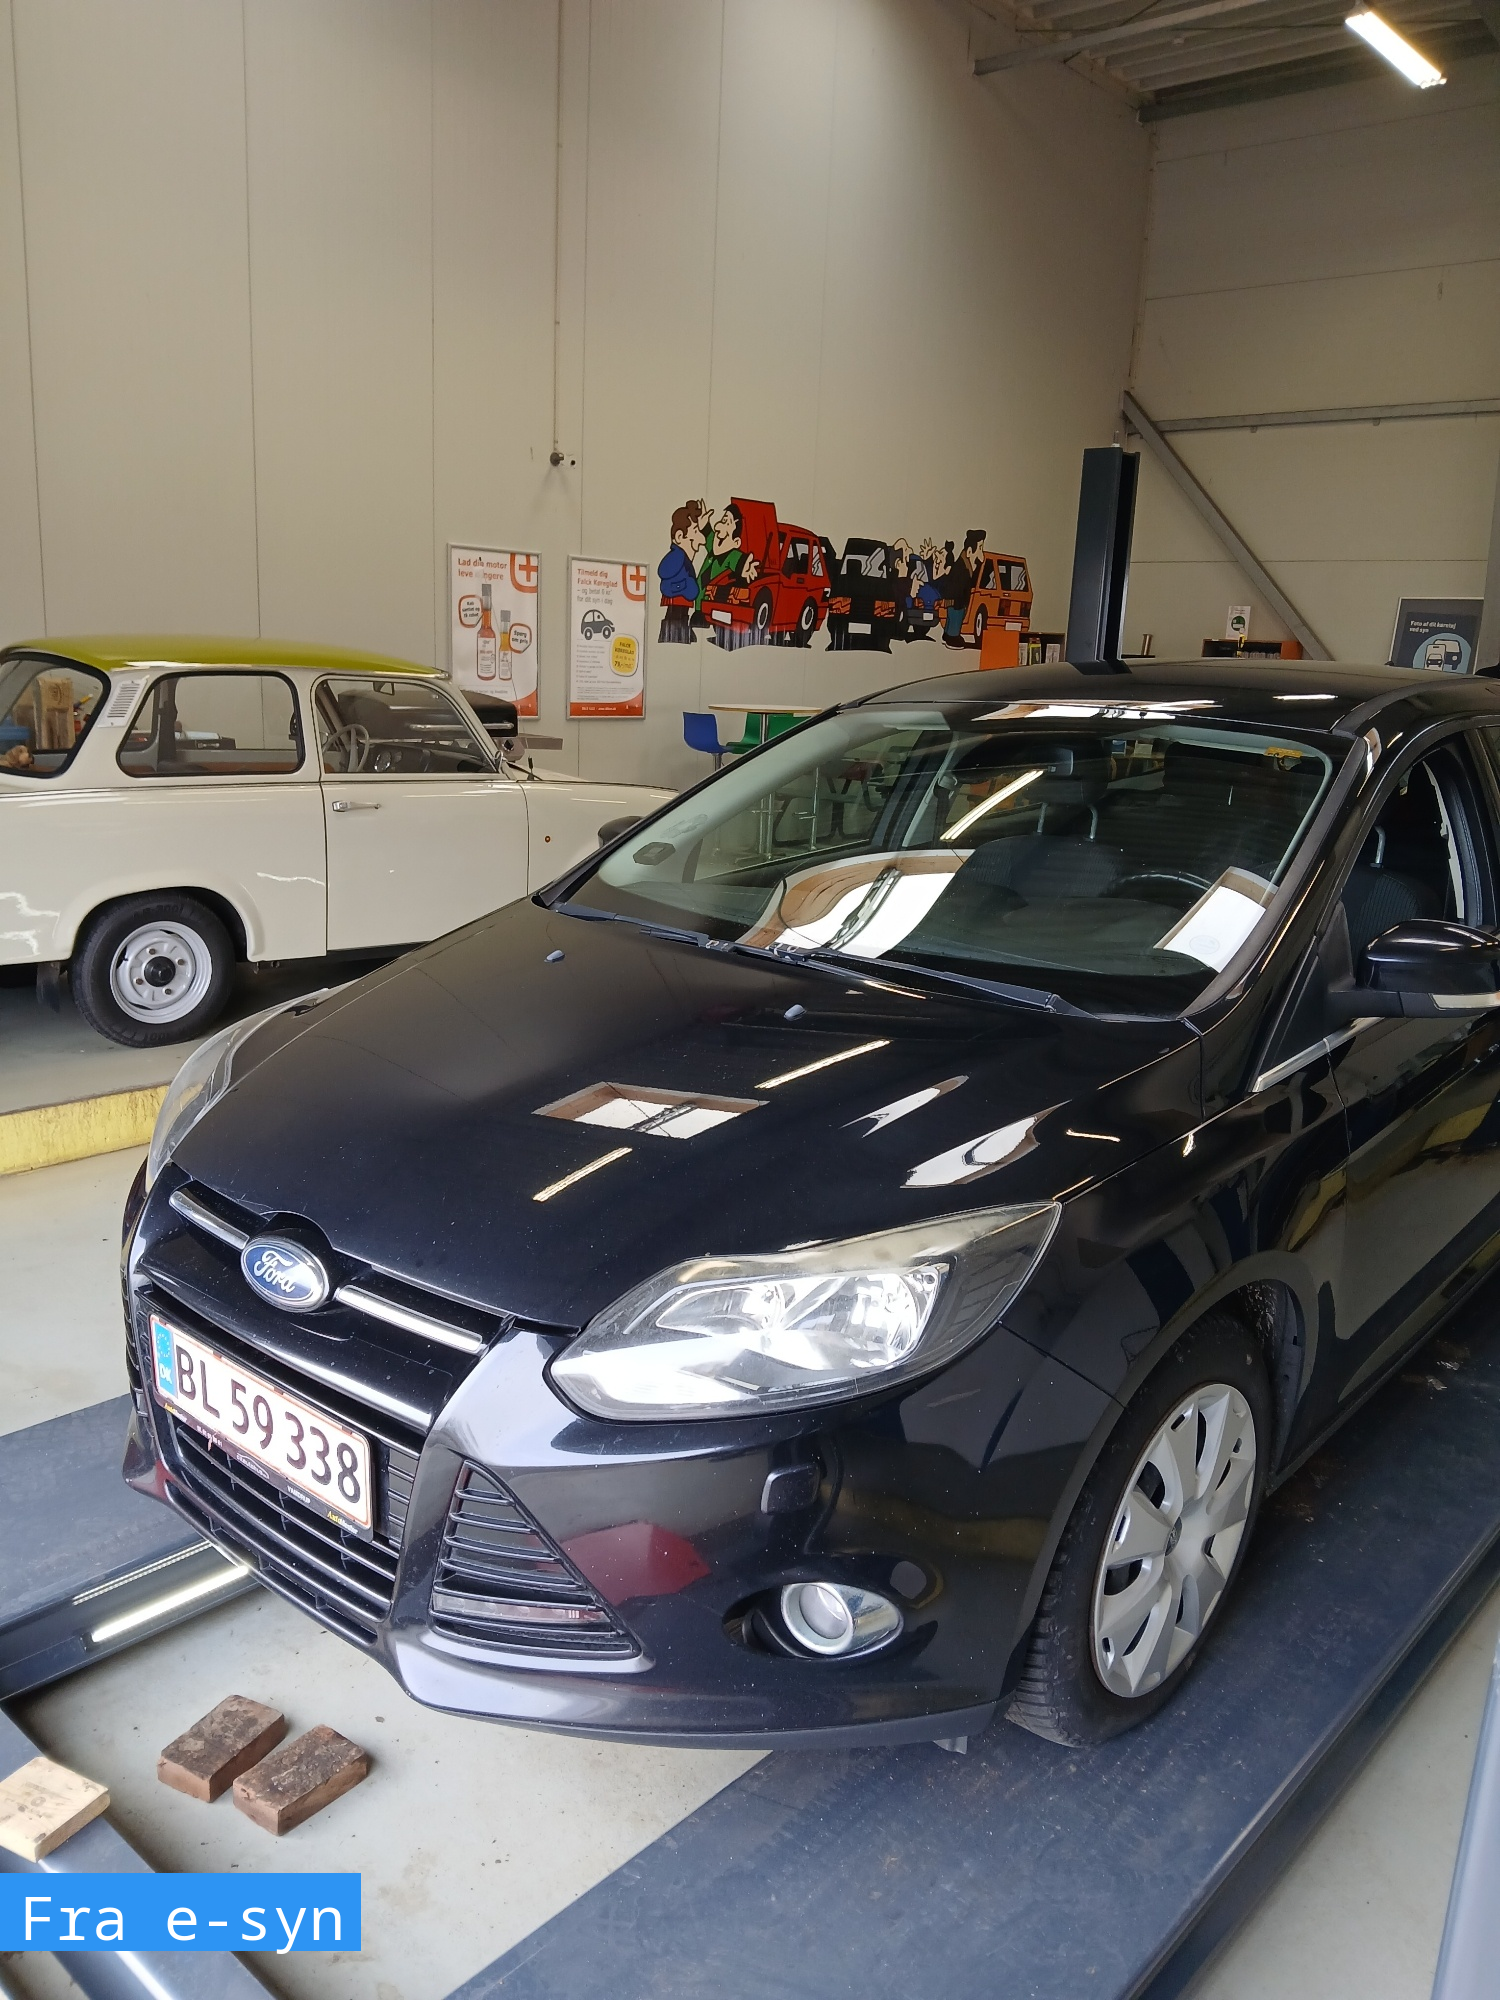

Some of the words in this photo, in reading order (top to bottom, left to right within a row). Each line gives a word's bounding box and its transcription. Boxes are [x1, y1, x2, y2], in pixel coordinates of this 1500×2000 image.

[458, 558, 471, 566] Lad
[486, 561, 507, 569] motor
[458, 569, 473, 577] leve
[577, 568, 598, 576] Tilmeld
[600, 570, 608, 579] dig
[577, 577, 591, 586] Falck
[254, 1250, 296, 1293] Ford
[159, 1364, 172, 1385] DK
[176, 1345, 220, 1419] BL
[230, 1378, 274, 1450] 59
[285, 1411, 361, 1504] 338
